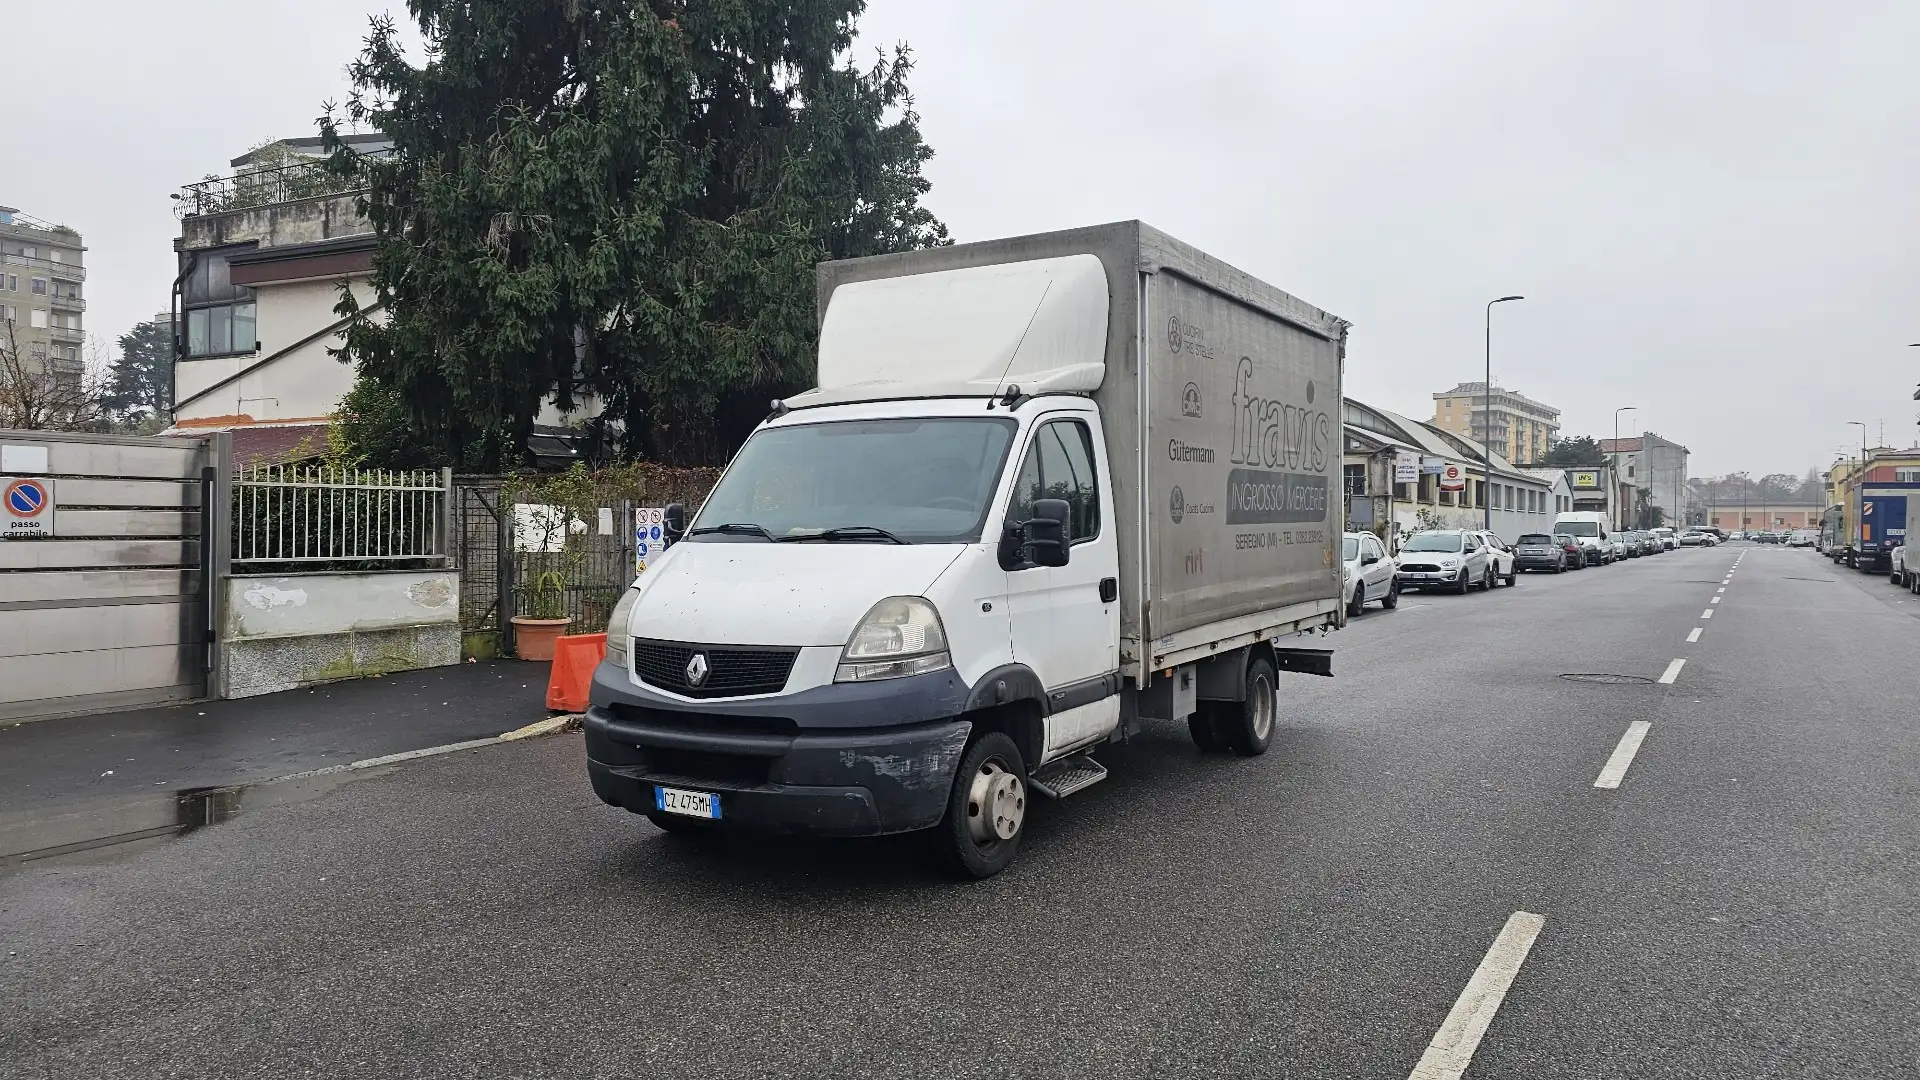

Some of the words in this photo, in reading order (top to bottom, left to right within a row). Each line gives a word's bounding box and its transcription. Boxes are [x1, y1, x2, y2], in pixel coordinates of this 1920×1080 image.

[1230, 355, 1329, 473] fravis
[1168, 438, 1215, 464] Gütermann
[1231, 482, 1285, 511] INGROSSO
[1286, 485, 1325, 511] MERCERIE
[1185, 503, 1199, 514] Coats
[3, 529, 49, 537] carrabile
[11, 521, 41, 529] passo
[1235, 532, 1266, 550] SEREGNO
[664, 792, 677, 809] CZ
[680, 794, 712, 813] 475MH
